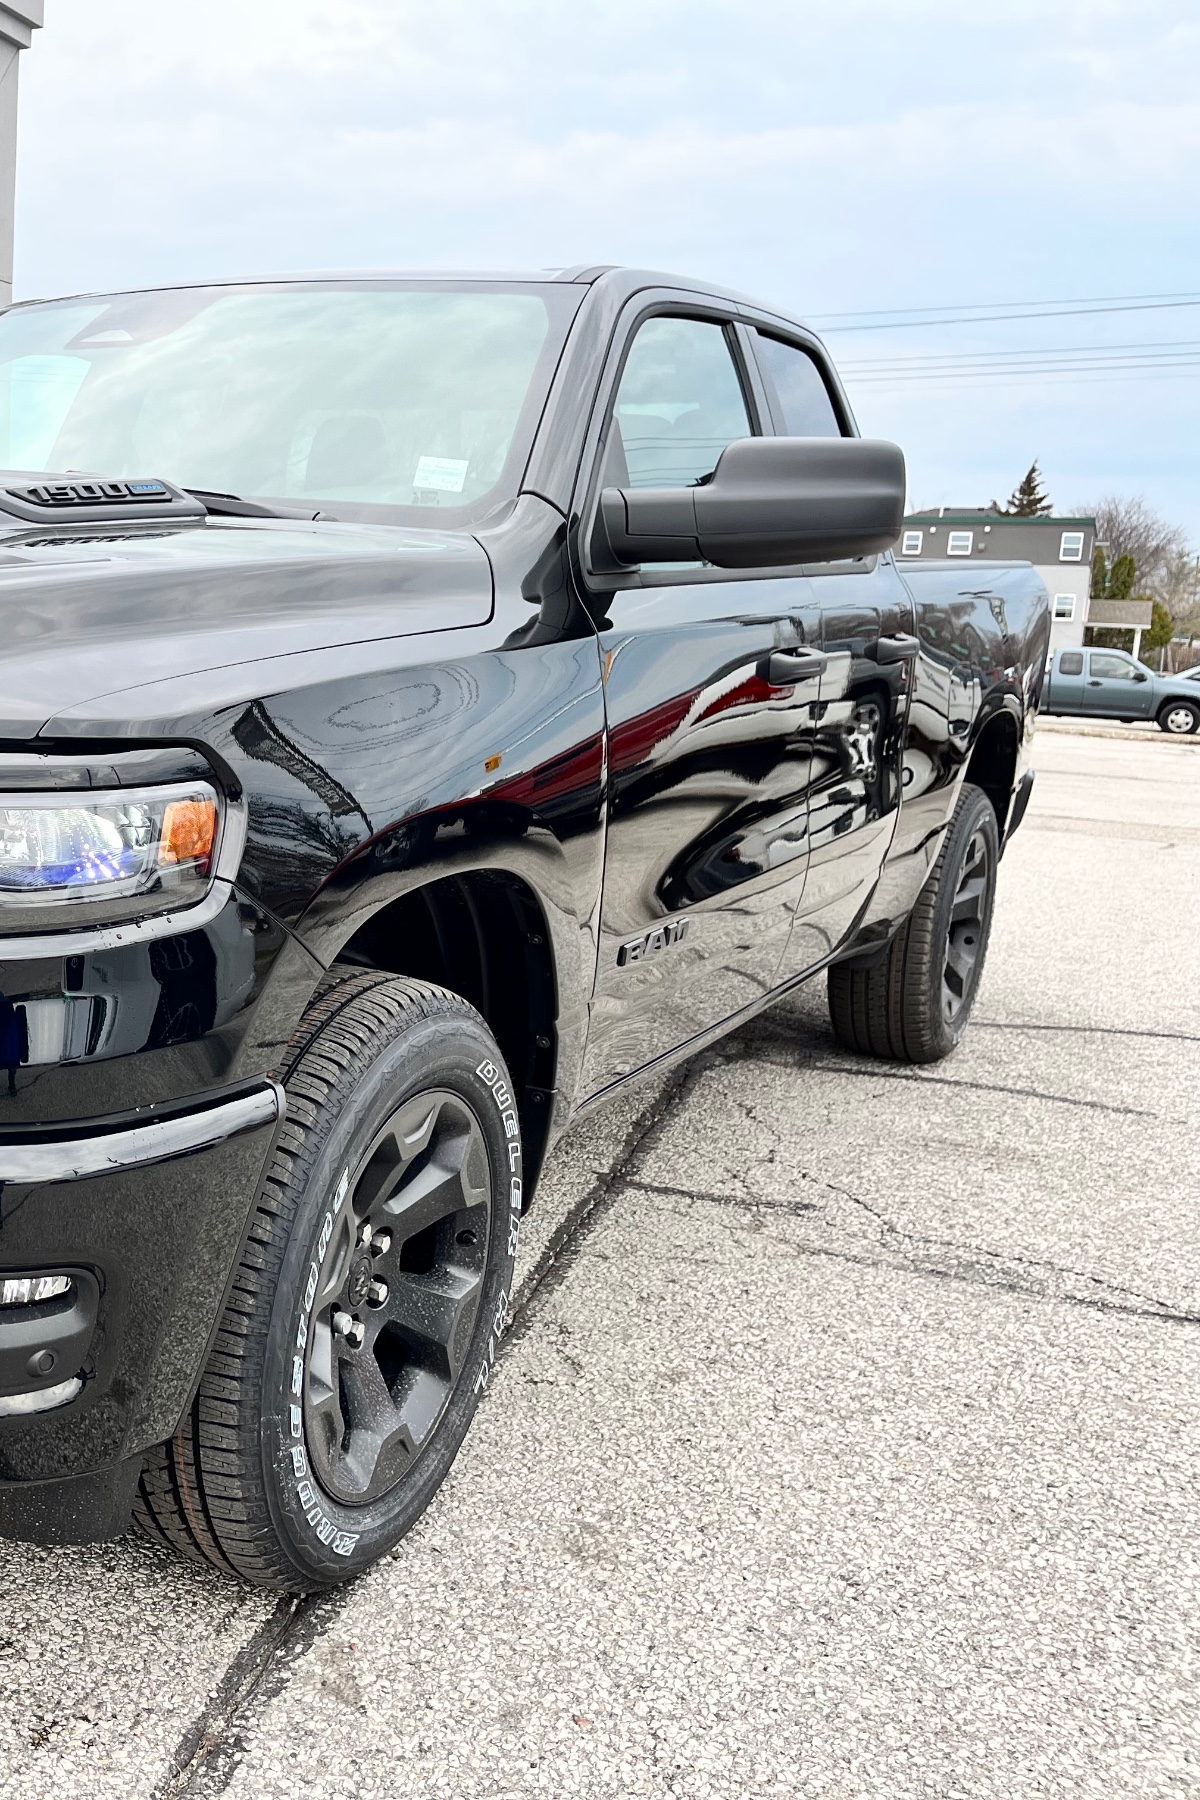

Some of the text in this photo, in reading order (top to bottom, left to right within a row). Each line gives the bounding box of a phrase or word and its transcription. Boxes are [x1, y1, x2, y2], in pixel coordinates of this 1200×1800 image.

[27, 482, 128, 502] 1500
[616, 917, 689, 966] RAM
[476, 1059, 522, 1256] DUELER
[288, 1166, 360, 1556] BRIDGESTONE
